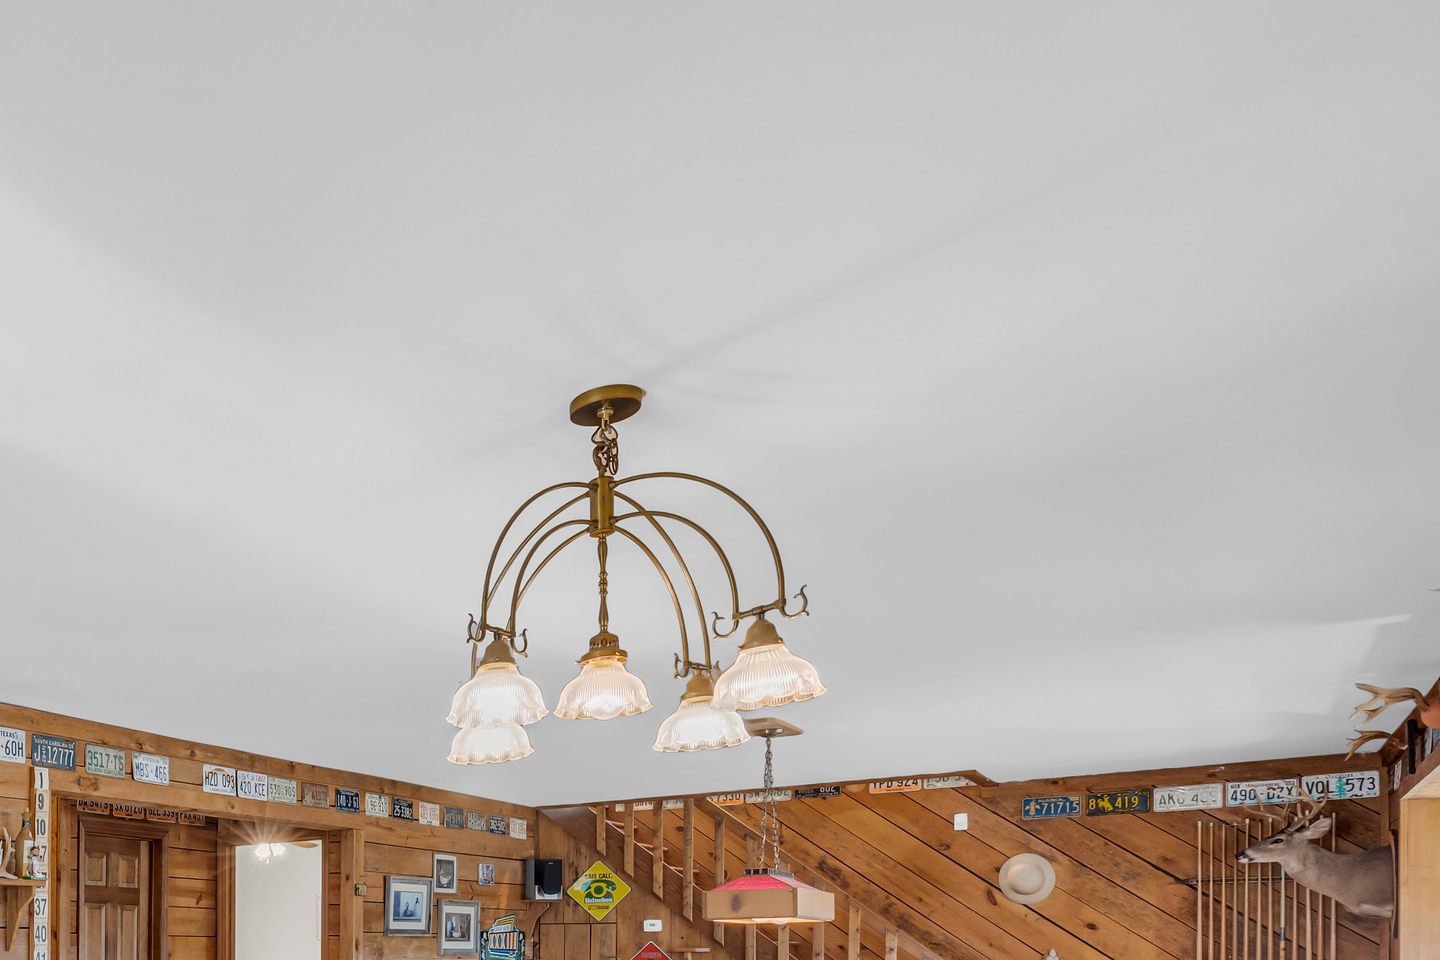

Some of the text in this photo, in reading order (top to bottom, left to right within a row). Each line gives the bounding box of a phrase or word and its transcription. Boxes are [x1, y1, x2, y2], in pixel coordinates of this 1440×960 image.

[0, 730, 15, 739] TEXAS
[1345, 777, 1376, 792] 573
[38, 793, 45, 811] 9
[1041, 801, 1080, 815] 71715
[1115, 796, 1139, 809] 419
[36, 819, 47, 836] 10
[598, 872, 613, 880] CALL
[34, 898, 47, 916] 37
[34, 925, 47, 943] 40
